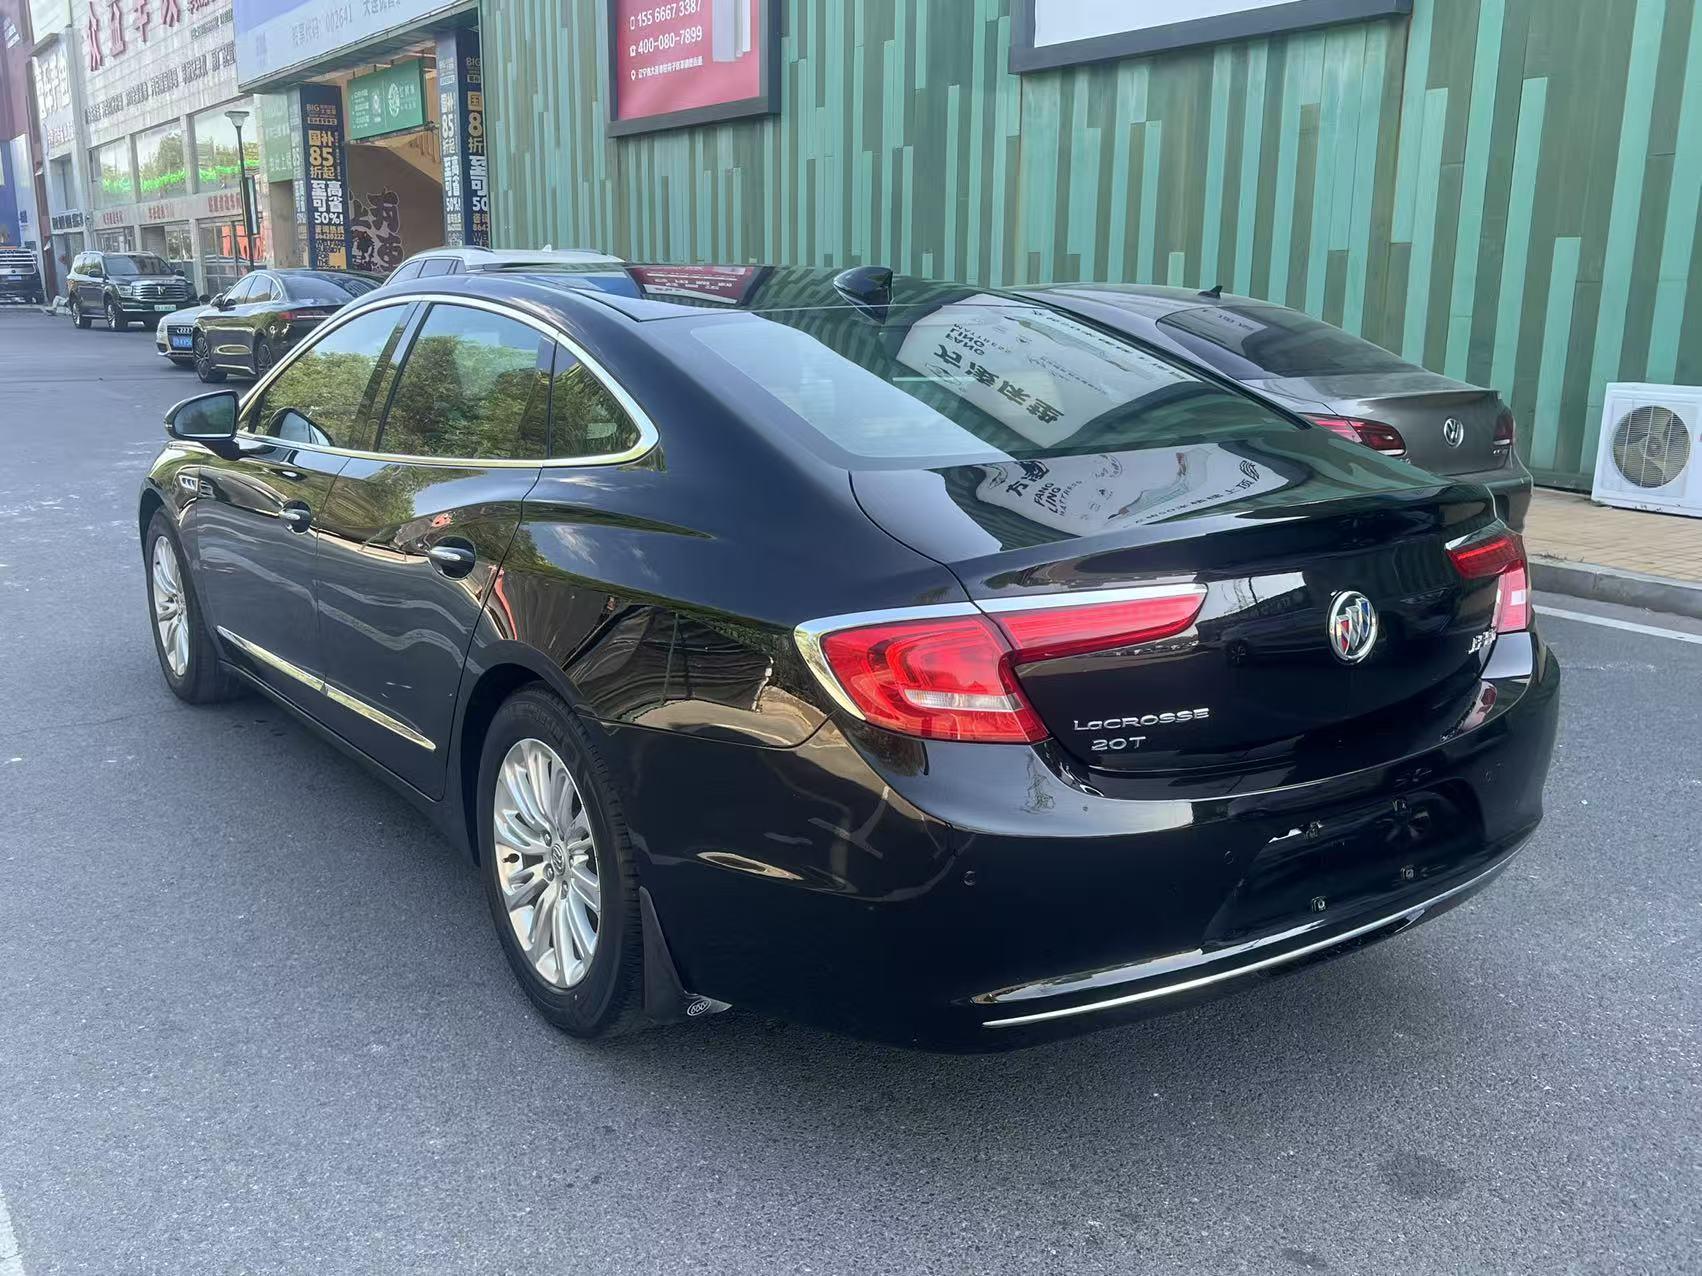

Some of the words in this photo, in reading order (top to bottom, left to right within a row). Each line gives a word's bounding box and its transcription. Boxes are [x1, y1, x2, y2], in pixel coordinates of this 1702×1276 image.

[638, 10, 653, 27] 155
[654, 3, 677, 22] 6667
[679, 0, 701, 16] 3387
[638, 25, 702, 54] 400-080-7899
[442, 113, 454, 138] 85
[308, 130, 334, 147] 国补
[310, 146, 334, 166] 85
[310, 166, 335, 179] 折起
[314, 212, 344, 224] 50%!
[1091, 736, 1146, 751] 20T
